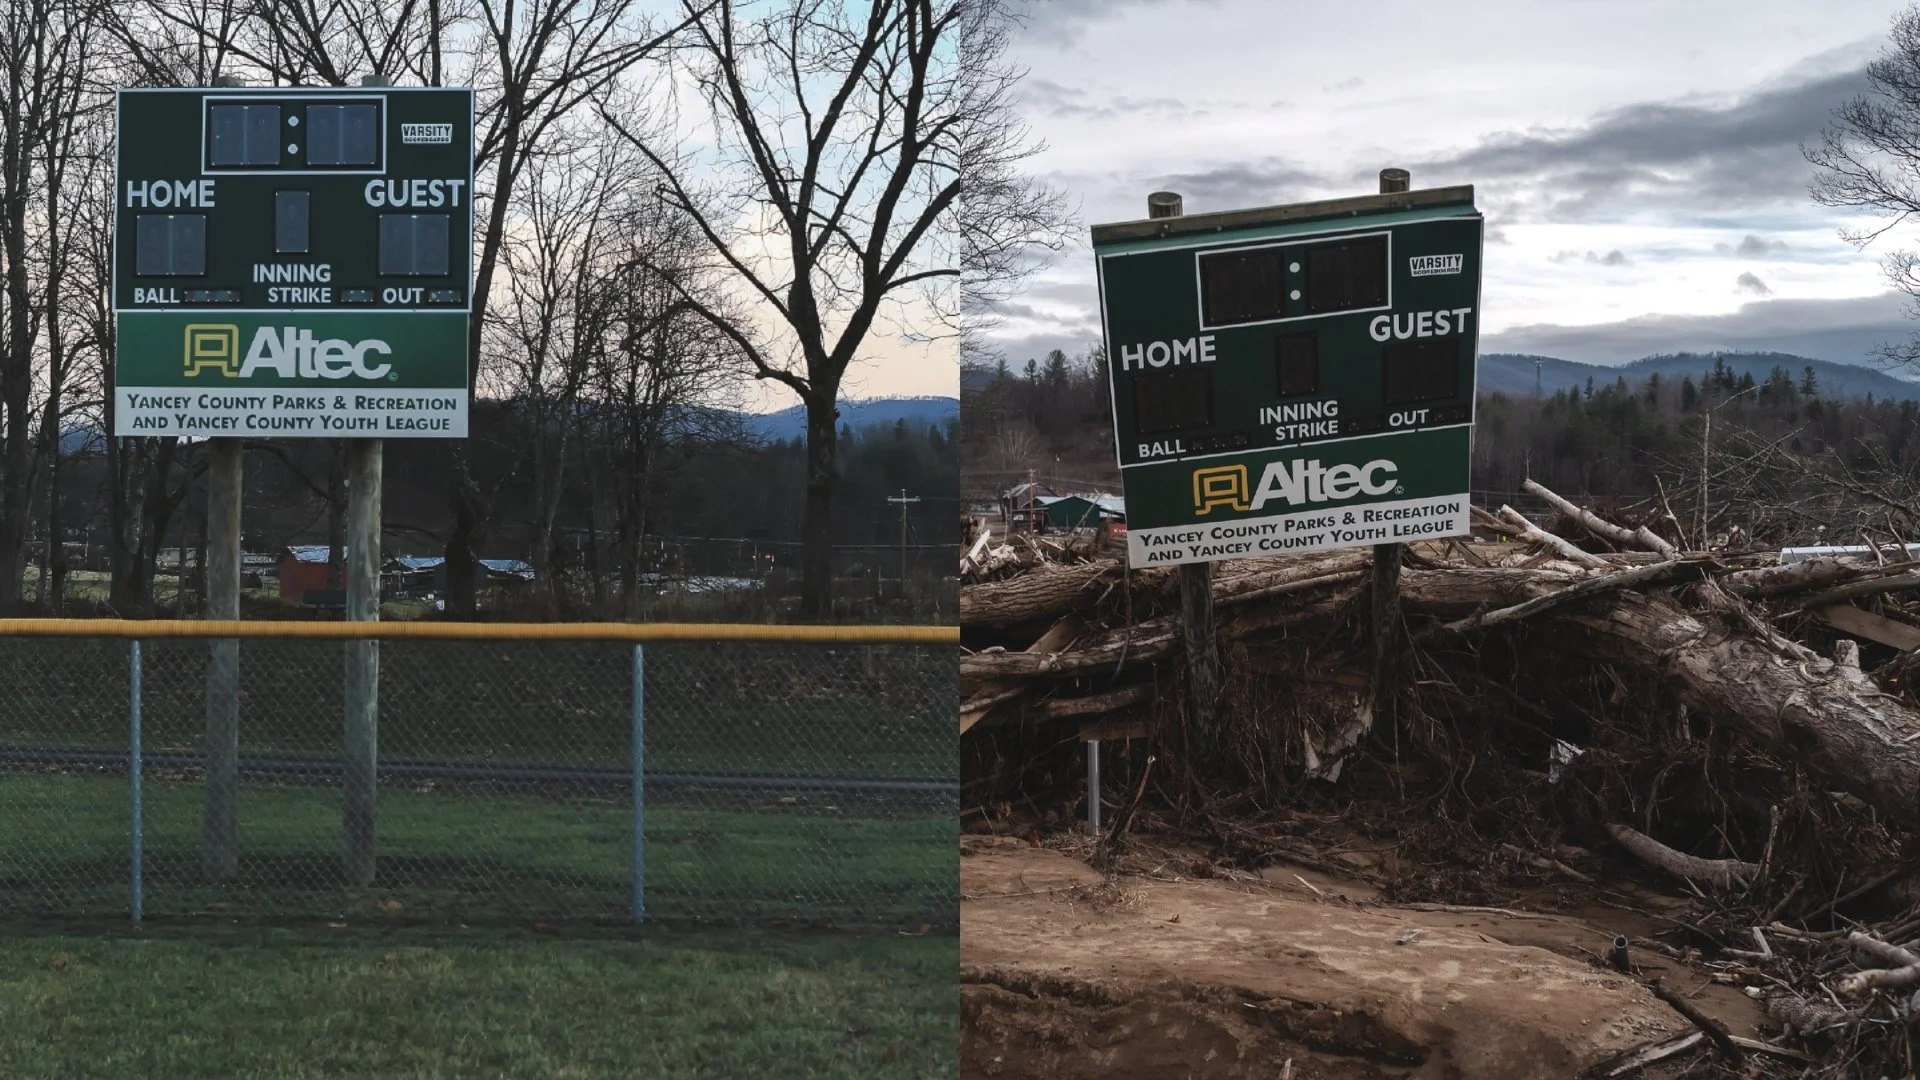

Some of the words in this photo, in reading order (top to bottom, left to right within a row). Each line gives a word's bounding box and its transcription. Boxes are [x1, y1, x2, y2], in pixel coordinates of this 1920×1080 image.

[403, 126, 451, 137] VARSITY
[127, 180, 215, 207] HOME
[364, 180, 465, 207] GUEST
[1411, 255, 1461, 270] VARSITY
[253, 264, 331, 282] INNING
[134, 288, 180, 303] BALL
[268, 288, 332, 303] STRIKE
[382, 288, 424, 303] OUT
[1369, 308, 1471, 342] GUEST
[238, 327, 392, 379] Altec
[1121, 335, 1217, 371] HOME
[127, 394, 192, 409] YANCEY
[198, 394, 266, 409] COUNTY
[272, 395, 326, 410] PARKS
[334, 396, 346, 410] &
[355, 396, 457, 410] RECREATION
[132, 416, 168, 429] AND
[174, 414, 240, 429] YANCEY
[245, 414, 314, 429] COUNTY
[319, 415, 379, 429] YOUTH
[386, 416, 450, 430] LEAGUE
[1259, 400, 1338, 425] INNING
[1389, 409, 1429, 427] OUT
[1275, 420, 1338, 441] STRIKE
[1138, 439, 1186, 458] BALL
[1249, 459, 1398, 511] Altec
[1140, 531, 1204, 547] YANCEY
[1211, 523, 1278, 540] COUNTY
[1284, 516, 1336, 532] PARKS
[1342, 512, 1355, 525] &
[1363, 502, 1460, 524] RECREATION
[1147, 549, 1183, 562] AND
[1188, 542, 1252, 558] YANCEY
[1258, 535, 1325, 551] COUNTY
[1330, 528, 1387, 543] YOUTH
[1392, 520, 1454, 537] LEAGUE
